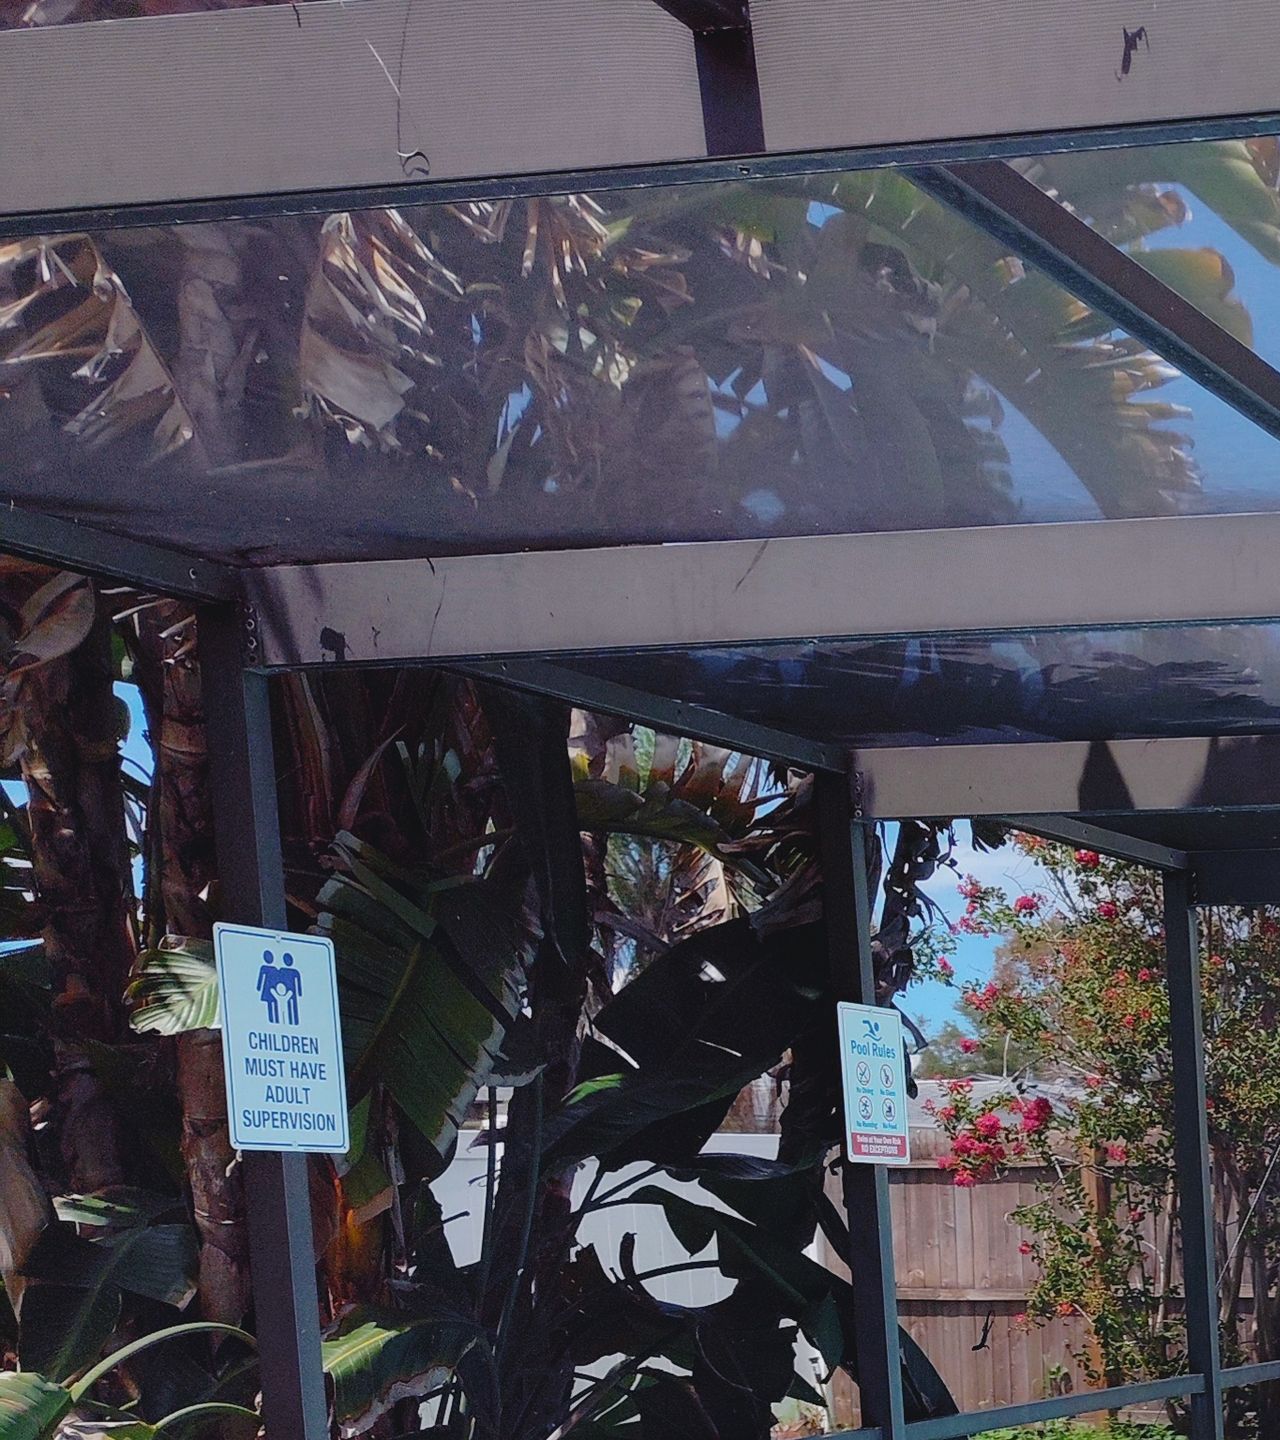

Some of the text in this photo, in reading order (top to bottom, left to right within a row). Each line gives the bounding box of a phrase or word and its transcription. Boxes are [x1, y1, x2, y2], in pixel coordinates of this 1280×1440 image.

[249, 1032, 319, 1055] CHILDREN
[850, 1039, 896, 1059] Pool Rules
[245, 1057, 327, 1080] MUST HAVE
[265, 1085, 311, 1105] ADULT
[243, 1109, 336, 1132] SUPERVISION
